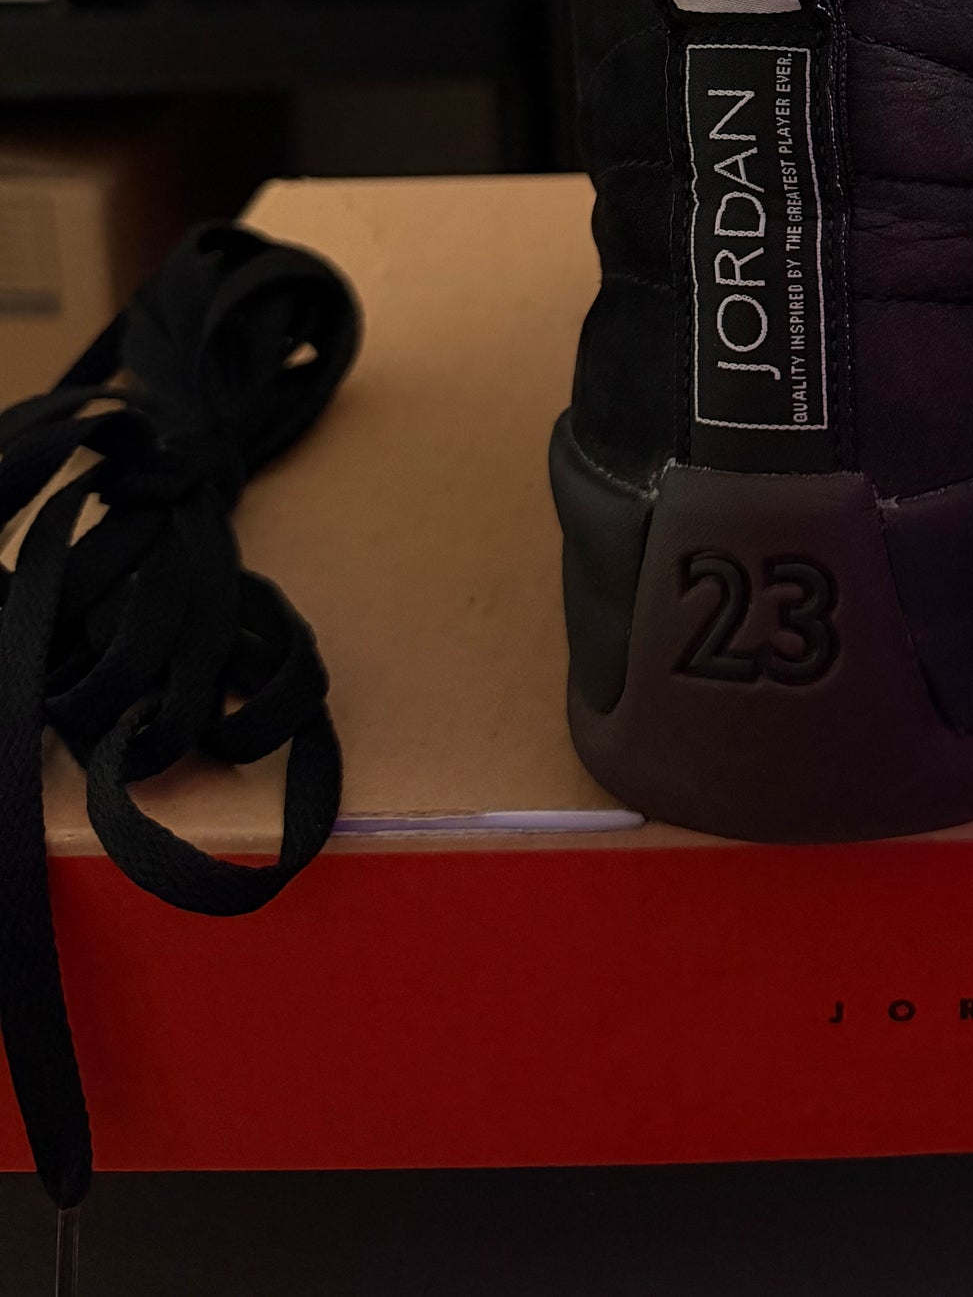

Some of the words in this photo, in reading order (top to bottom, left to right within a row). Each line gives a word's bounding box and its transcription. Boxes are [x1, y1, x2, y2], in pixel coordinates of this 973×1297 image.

[775, 52, 793, 93] EVER.
[775, 97, 793, 154] PLAYER
[780, 159, 803, 222] GREATEST
[707, 89, 781, 380] JORDAN
[785, 225, 803, 252] THE
[785, 258, 803, 279] BY
[788, 284, 806, 350] INSPIRED
[790, 355, 808, 423] QUALITY
[674, 550, 841, 687] 23
